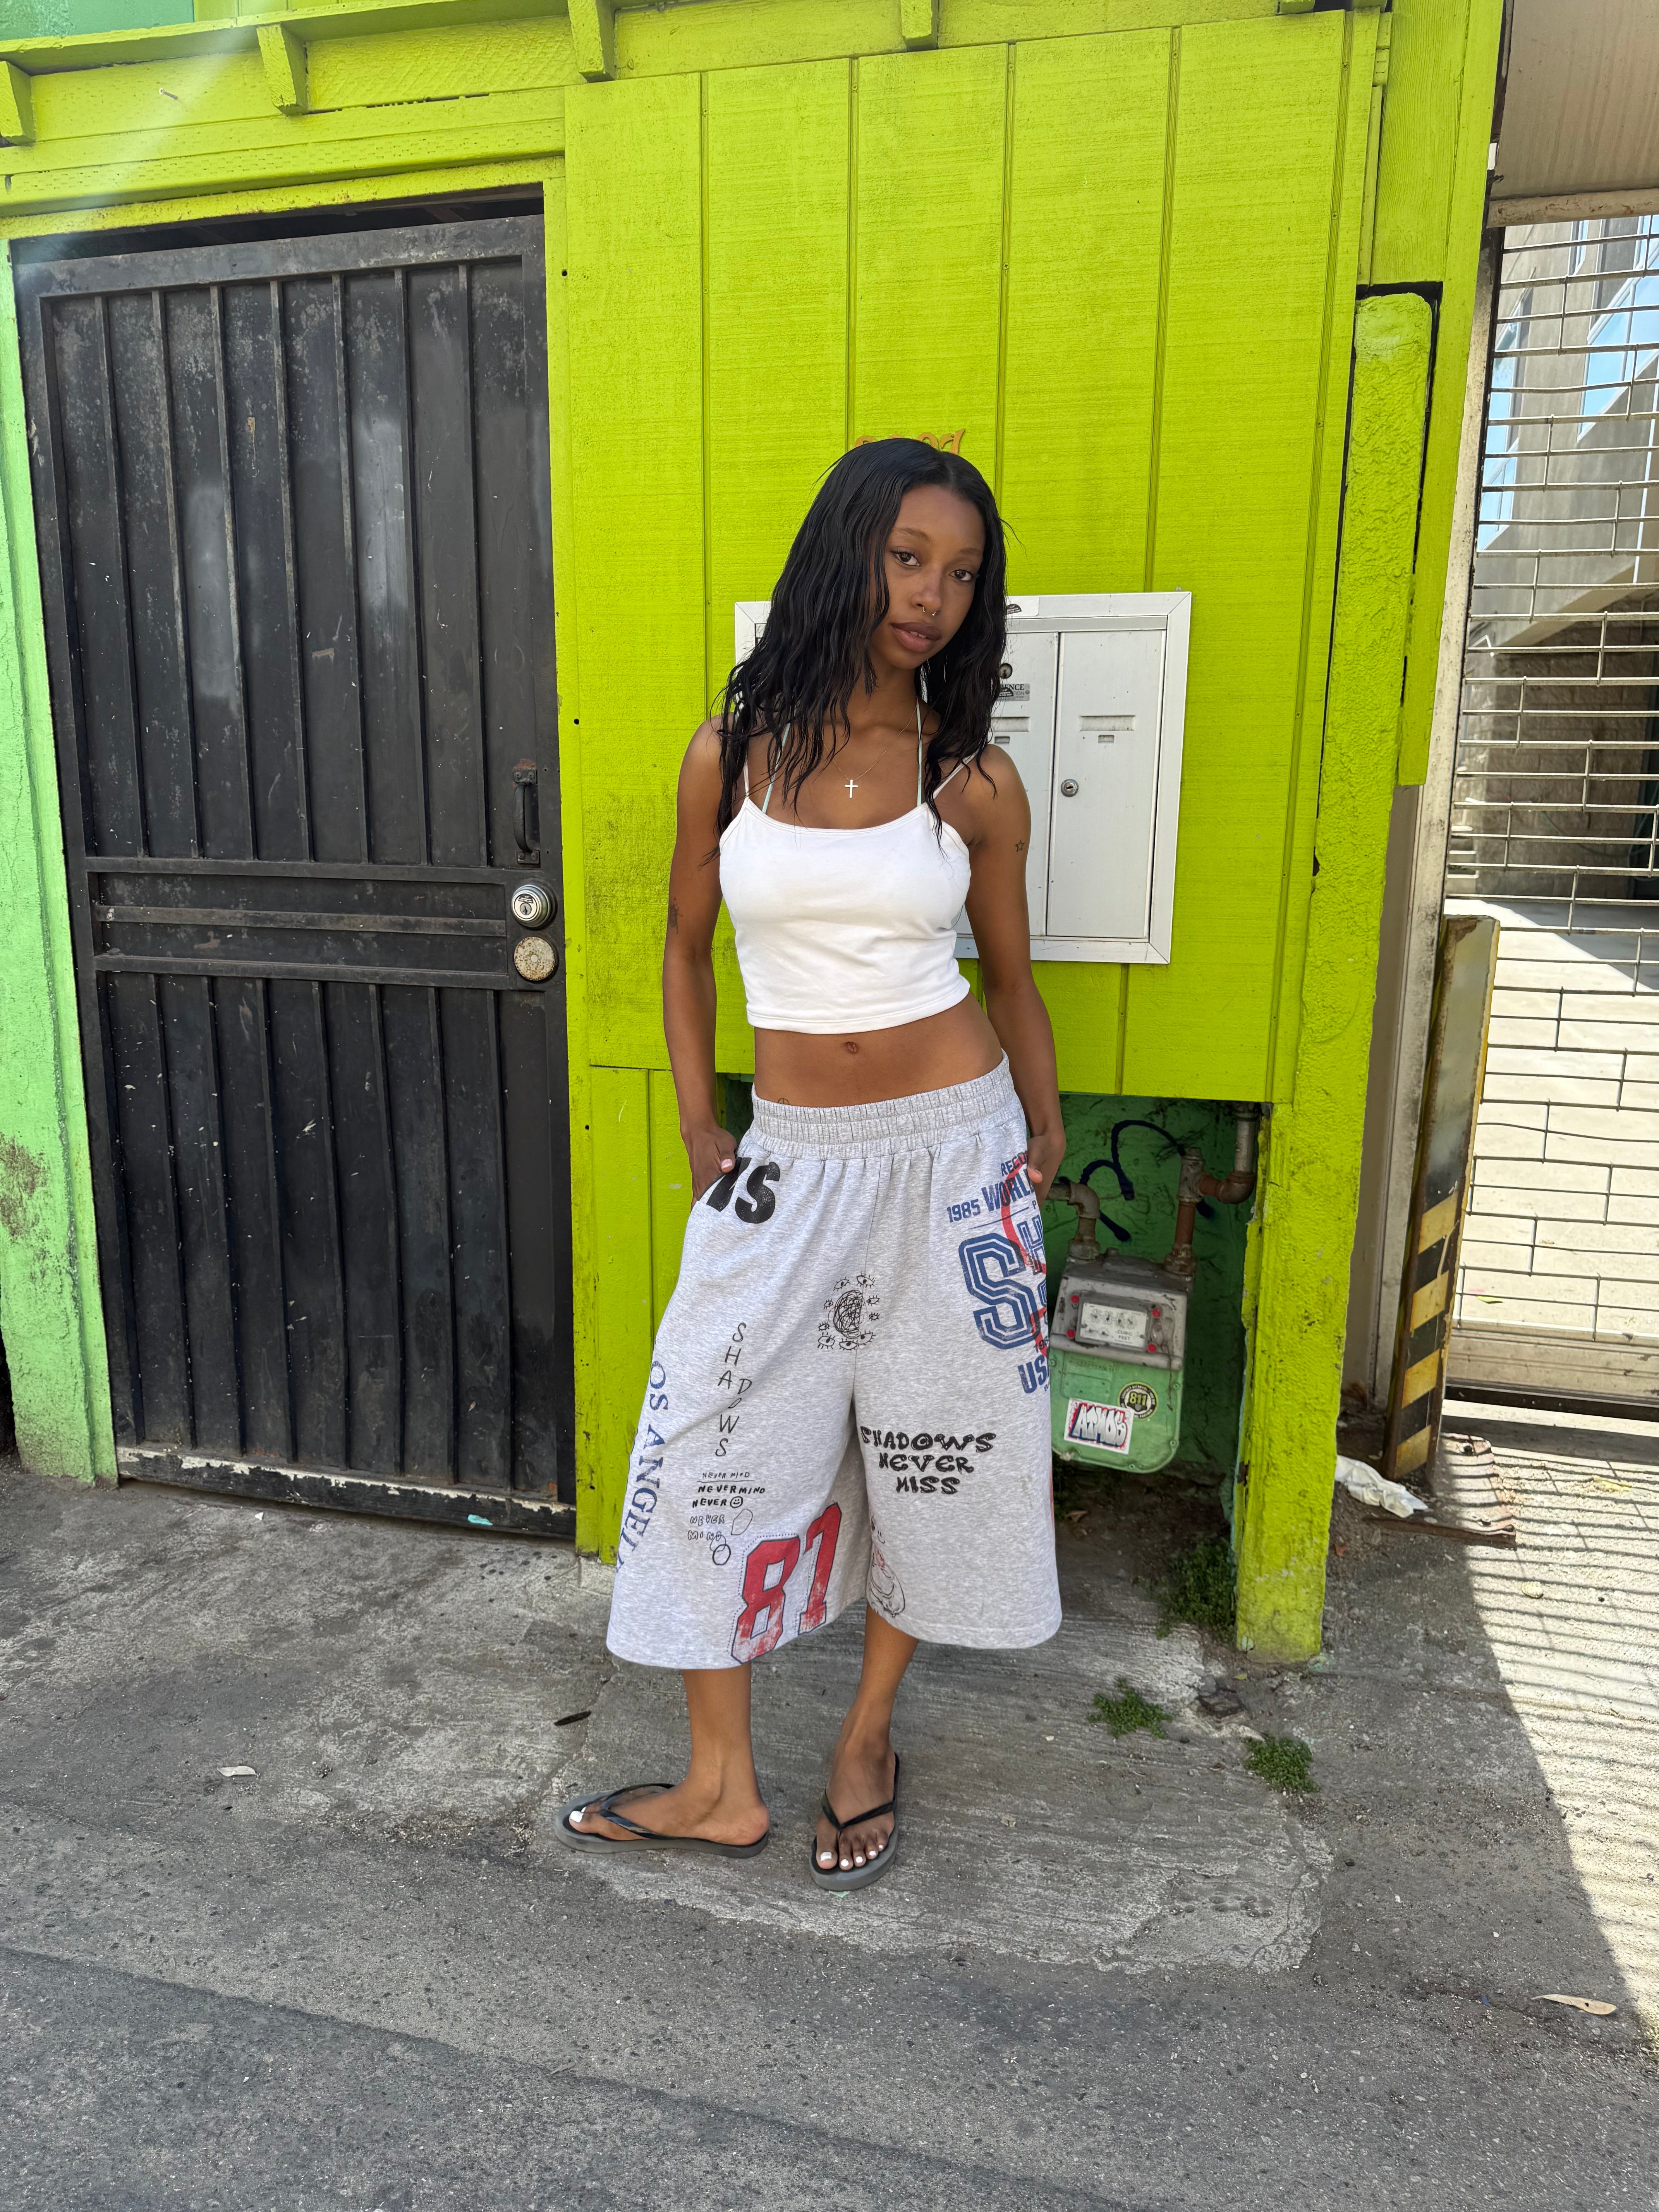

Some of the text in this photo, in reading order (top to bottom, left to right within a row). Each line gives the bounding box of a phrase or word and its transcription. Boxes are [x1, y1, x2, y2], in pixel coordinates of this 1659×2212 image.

[947, 1199, 981, 1223] 1985
[1018, 1355, 1049, 1394] US
[1129, 1391, 1147, 1406] 811
[860, 1426, 996, 1453] SHADOWS
[879, 1452, 975, 1474] NEVER
[692, 1498, 728, 1508] NEVER
[690, 1514, 725, 1527] NEVER
